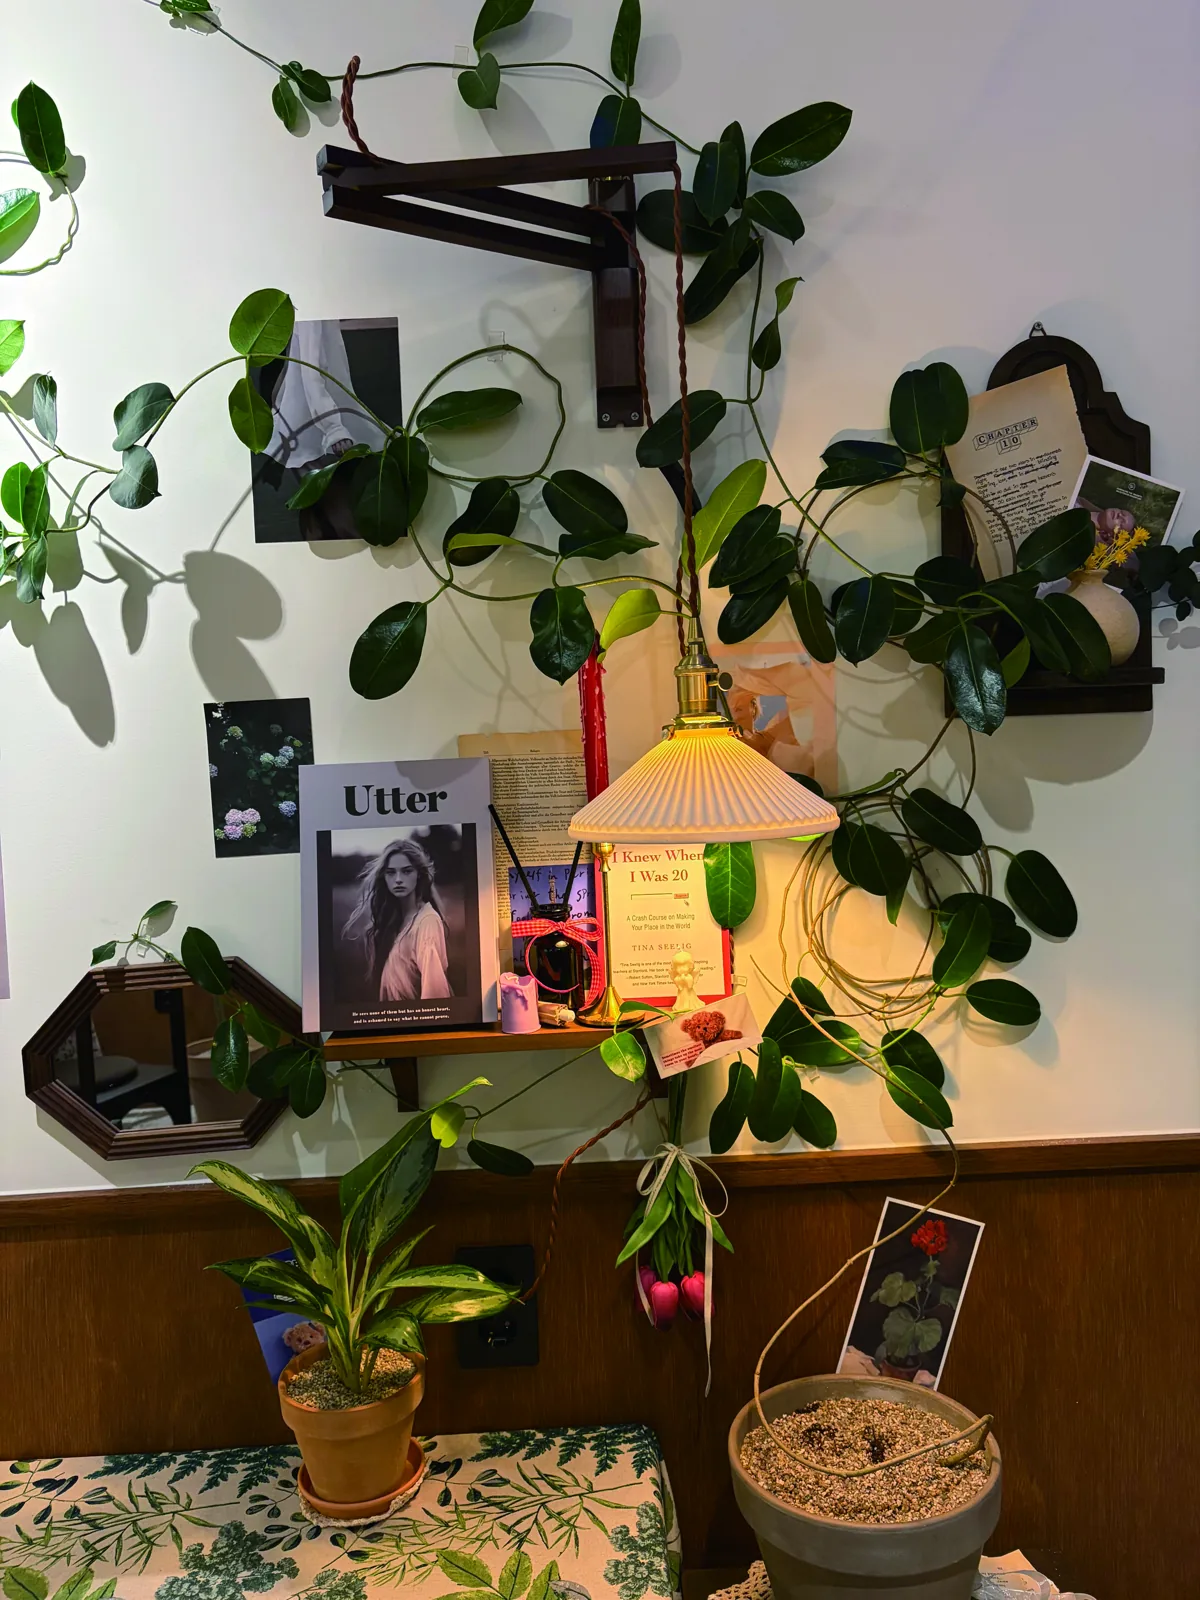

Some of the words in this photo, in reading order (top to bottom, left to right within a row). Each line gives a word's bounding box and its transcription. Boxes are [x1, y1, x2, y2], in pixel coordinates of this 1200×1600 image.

[977, 417, 1037, 444] CHAPTER
[1000, 436, 1019, 448] 10
[343, 784, 447, 817] Utter
[611, 851, 618, 863] I
[622, 850, 661, 863] Knew
[665, 848, 704, 861] When
[630, 870, 636, 882] I
[640, 869, 668, 882] Was
[672, 868, 688, 881] 20
[648, 913, 667, 921] Course
[676, 912, 695, 921] Making
[658, 943, 692, 951] SEELIG
